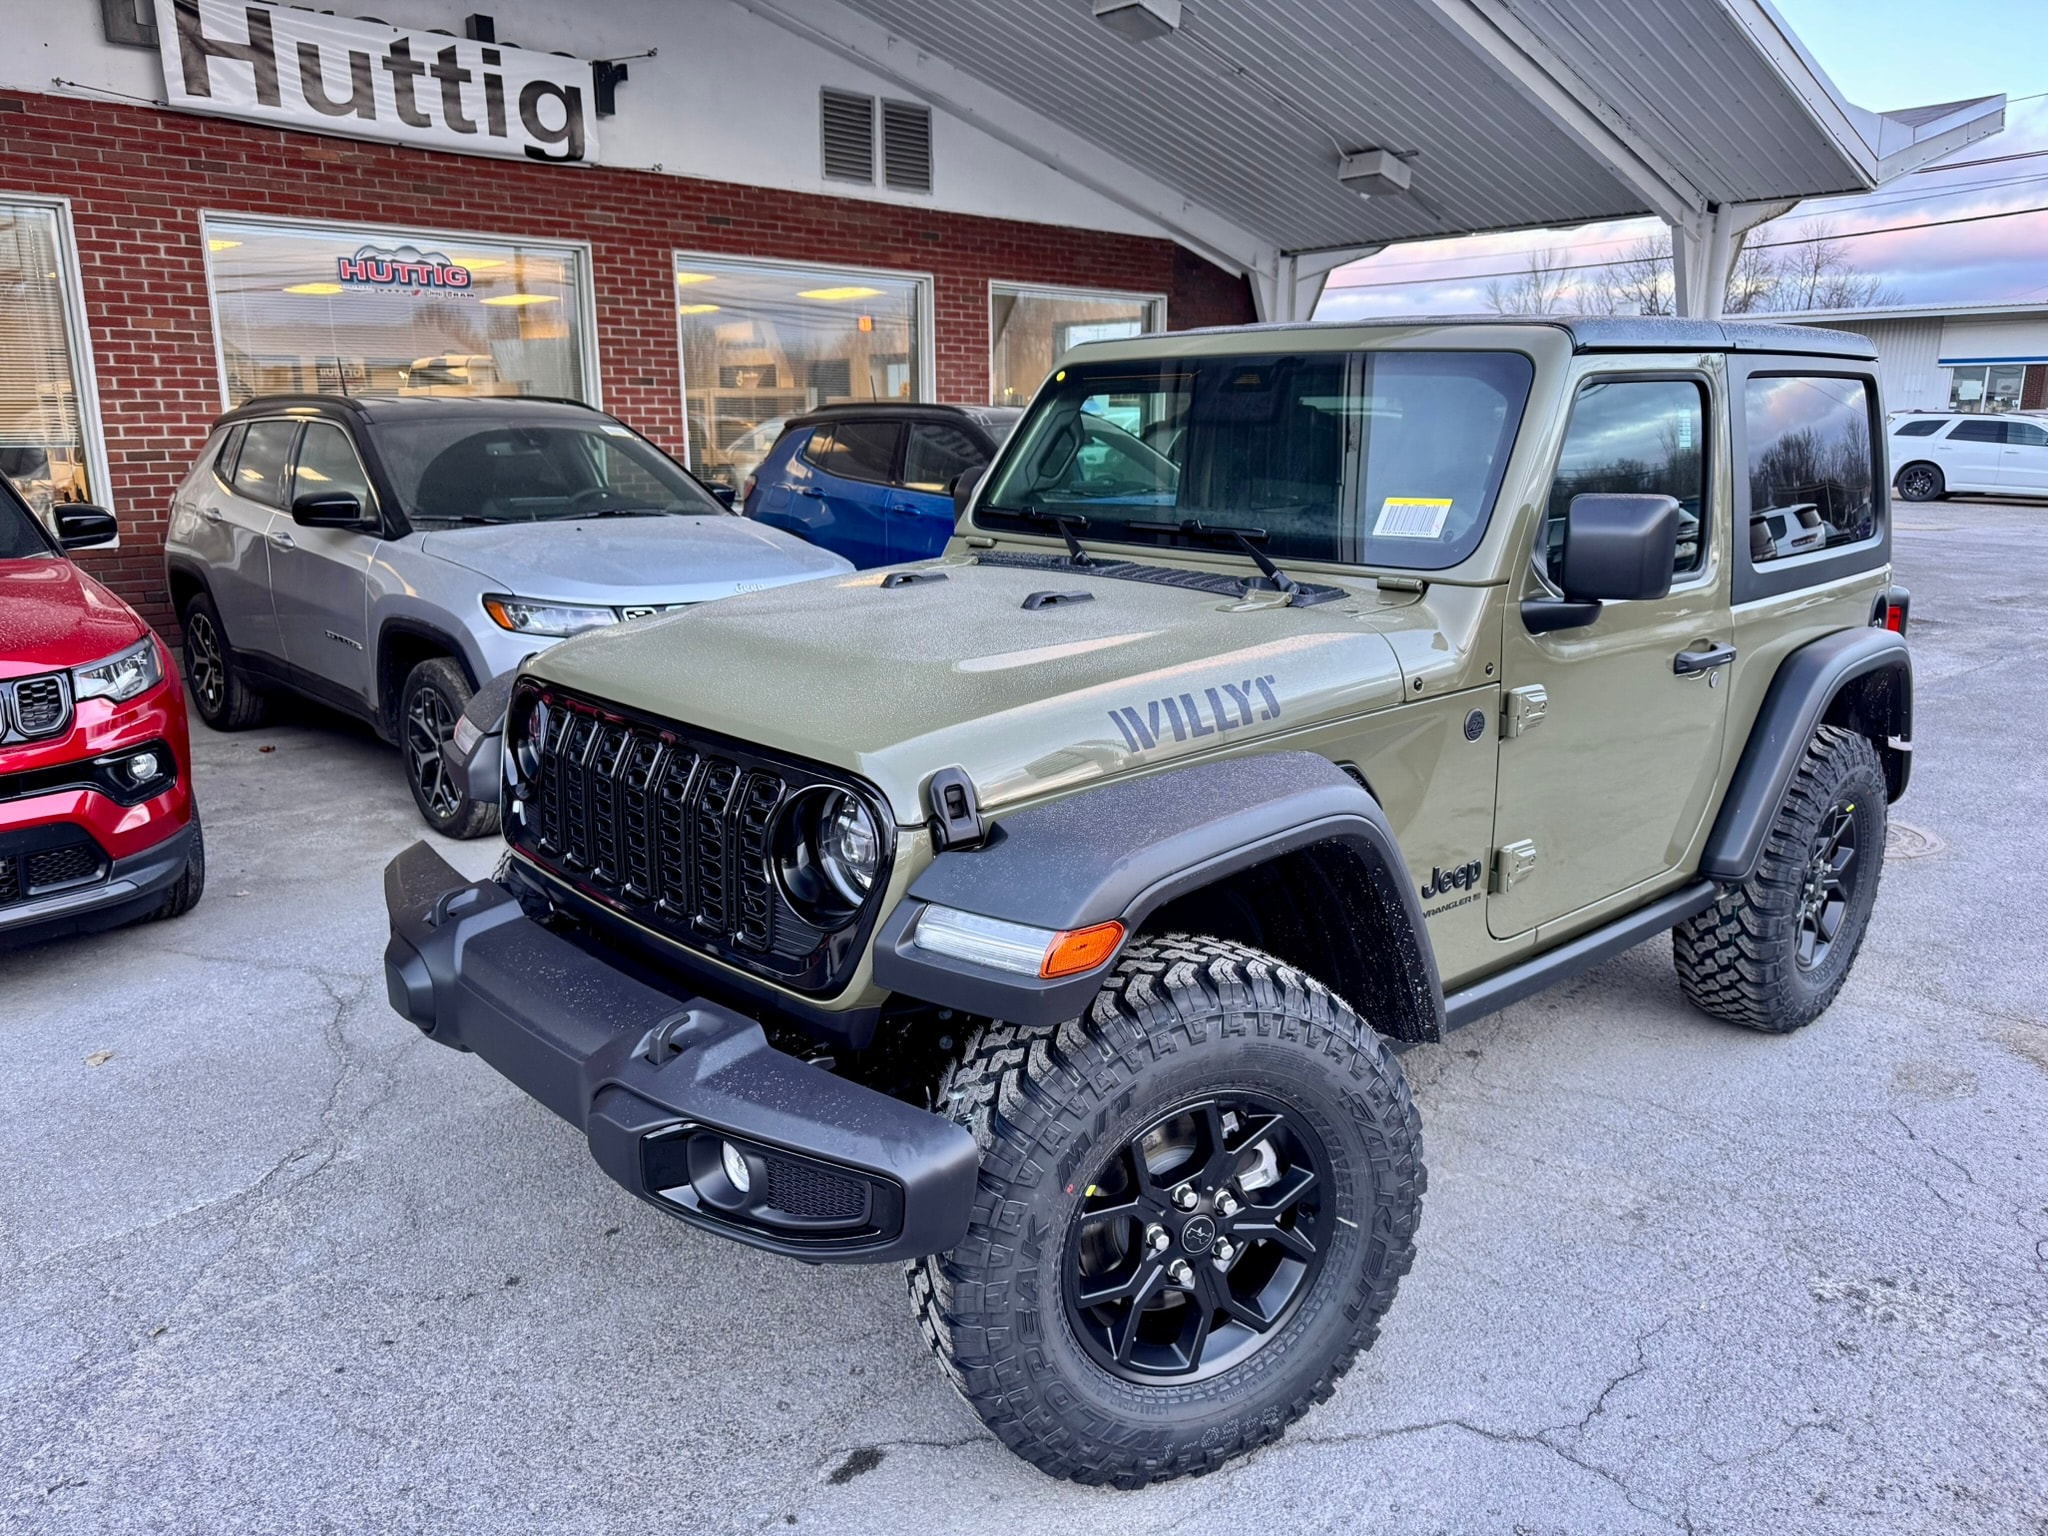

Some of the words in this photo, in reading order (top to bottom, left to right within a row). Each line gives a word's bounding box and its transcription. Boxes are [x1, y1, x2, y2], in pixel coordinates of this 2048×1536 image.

[174, 0, 586, 162] Huttig
[338, 257, 471, 288] HUTTIG
[1107, 674, 1281, 752] WILLYS
[1421, 859, 1482, 899] Jeep
[1339, 1086, 1395, 1323] FALKEN
[1015, 1212, 1172, 1450] WILDPEAK
